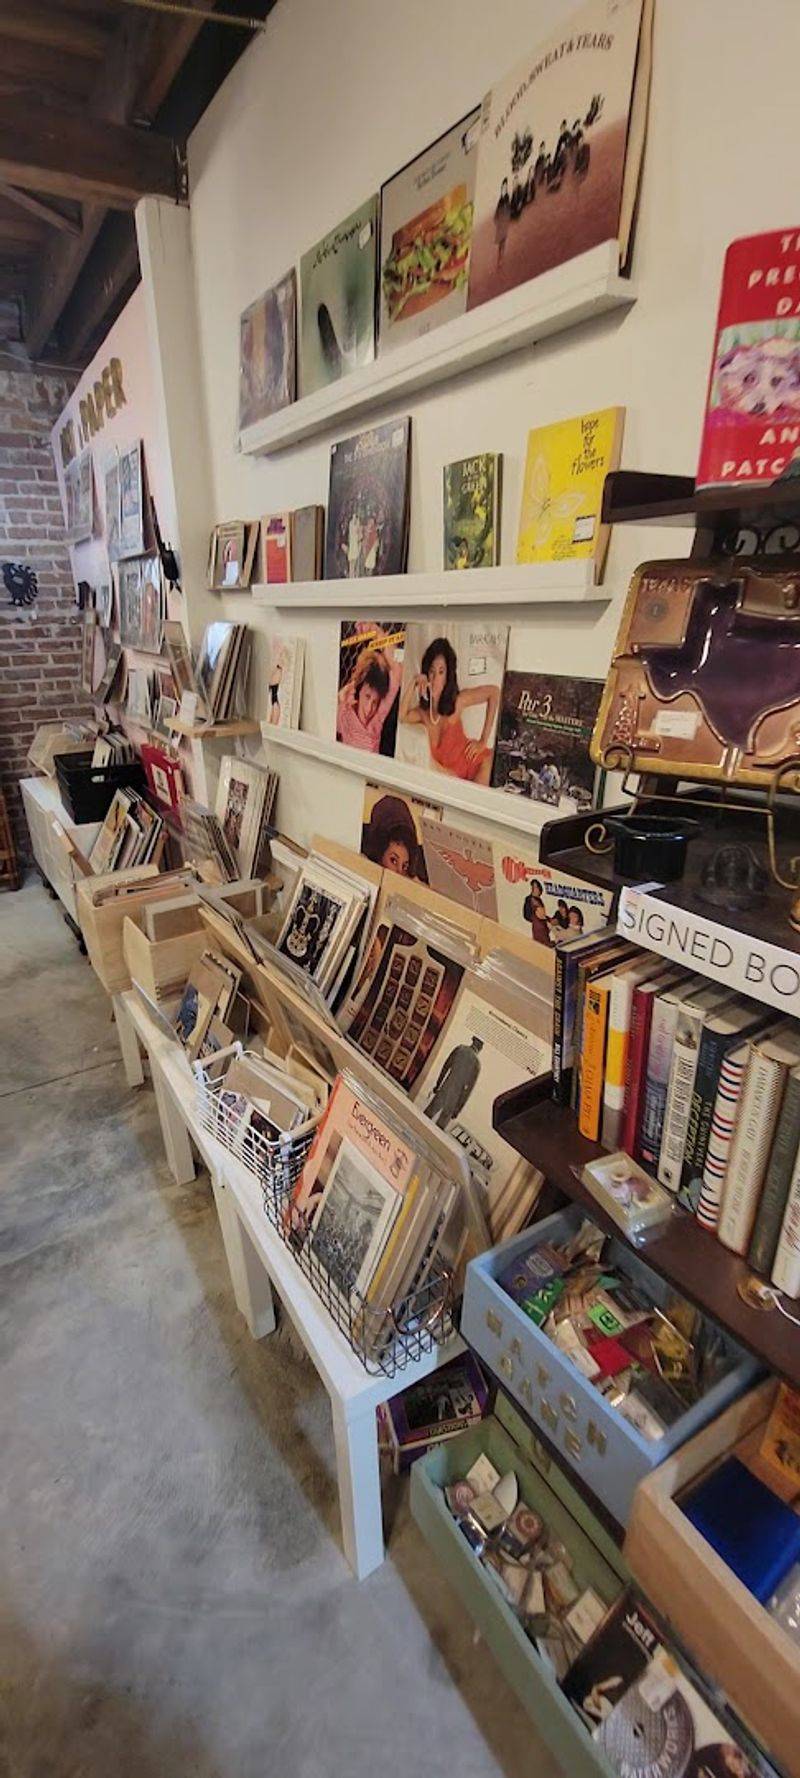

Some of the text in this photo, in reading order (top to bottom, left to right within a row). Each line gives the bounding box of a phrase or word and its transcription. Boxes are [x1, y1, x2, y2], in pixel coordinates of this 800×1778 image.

[576, 33, 614, 50] TEARS
[581, 418, 599, 436] hope
[571, 454, 605, 476] flowers
[517, 689, 541, 714] Par
[539, 694, 553, 718] 3
[622, 900, 735, 969] SIGNED
[352, 1101, 391, 1152] Evergreen
